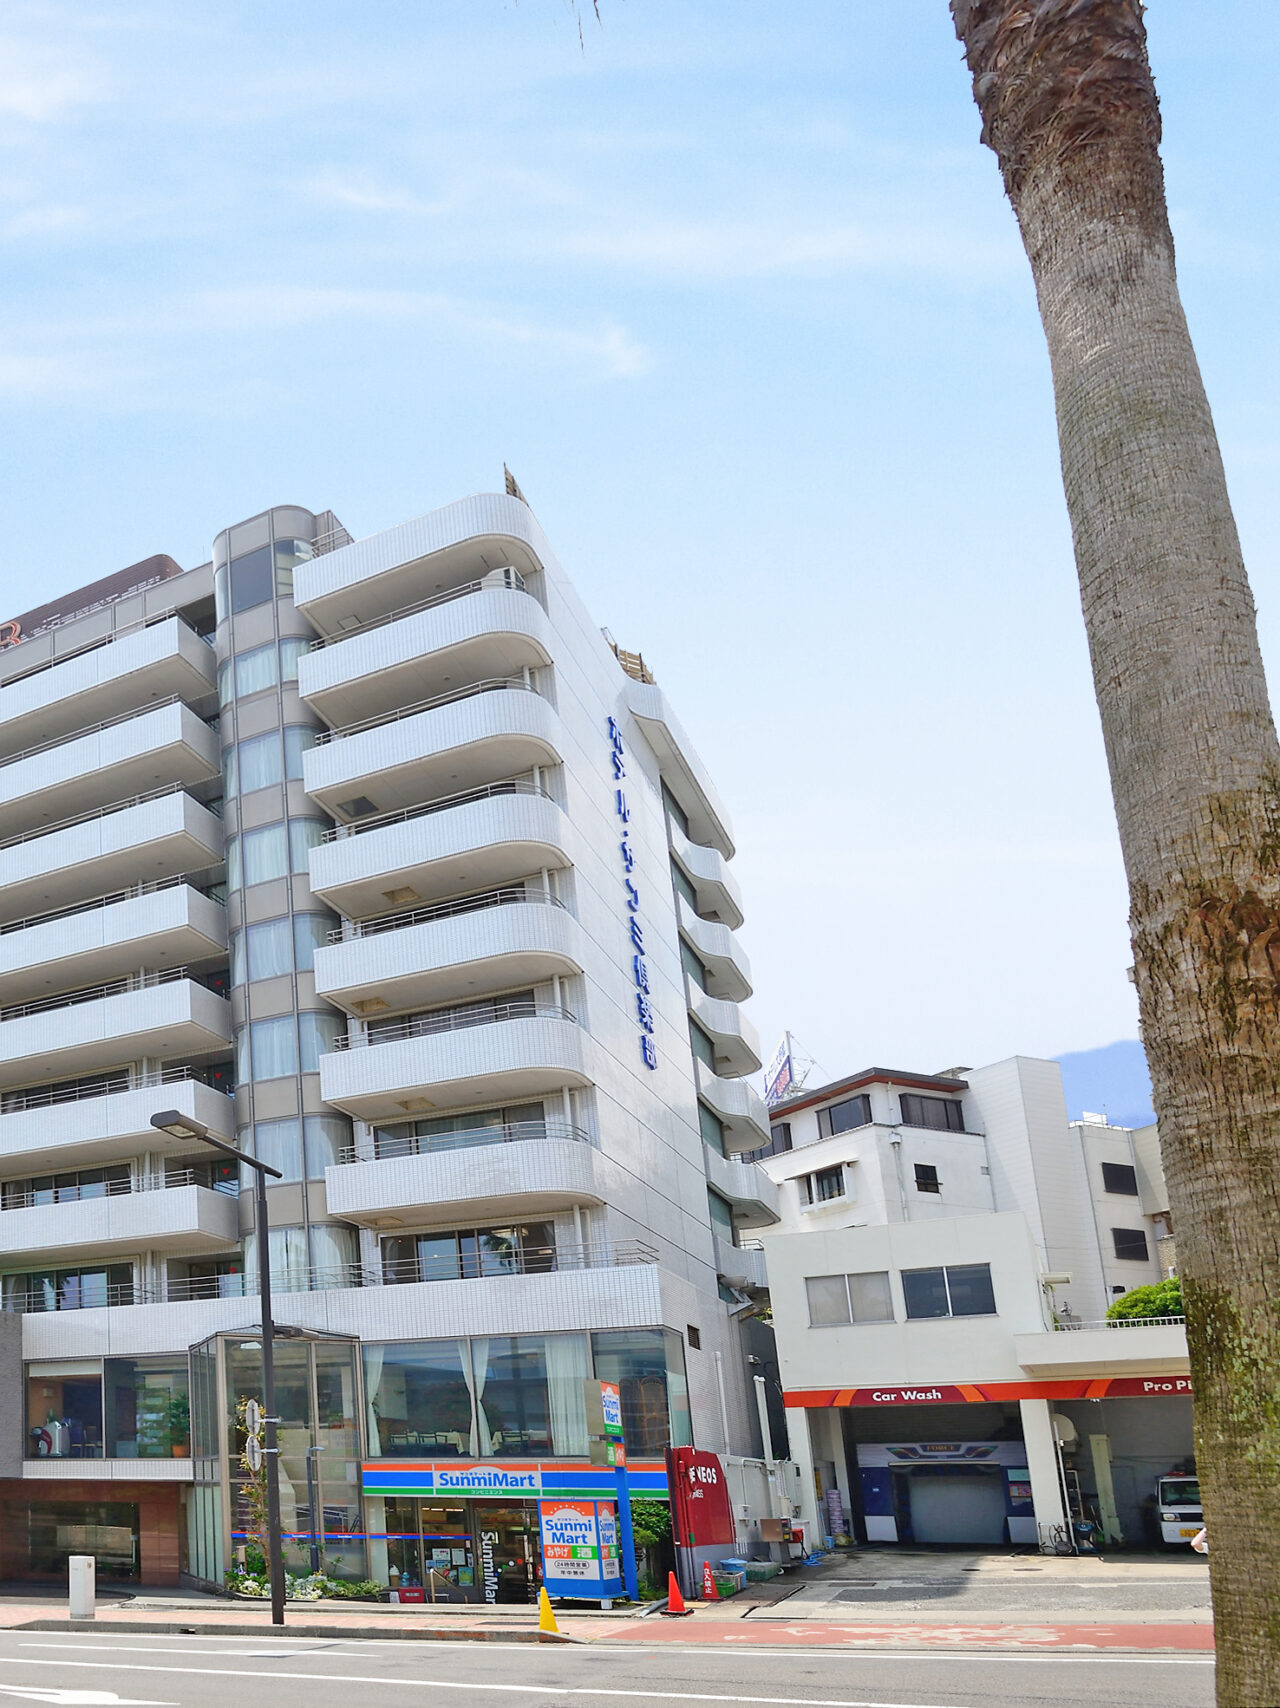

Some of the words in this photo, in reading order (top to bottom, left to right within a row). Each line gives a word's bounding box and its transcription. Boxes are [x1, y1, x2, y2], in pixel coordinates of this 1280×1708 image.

[1143, 1382, 1173, 1391] Pro
[872, 1392, 897, 1402] Car
[901, 1389, 942, 1400] Wash
[439, 1472, 535, 1487] SunmiMart
[545, 1519, 592, 1532] Sunmi
[552, 1532, 588, 1544] Mart
